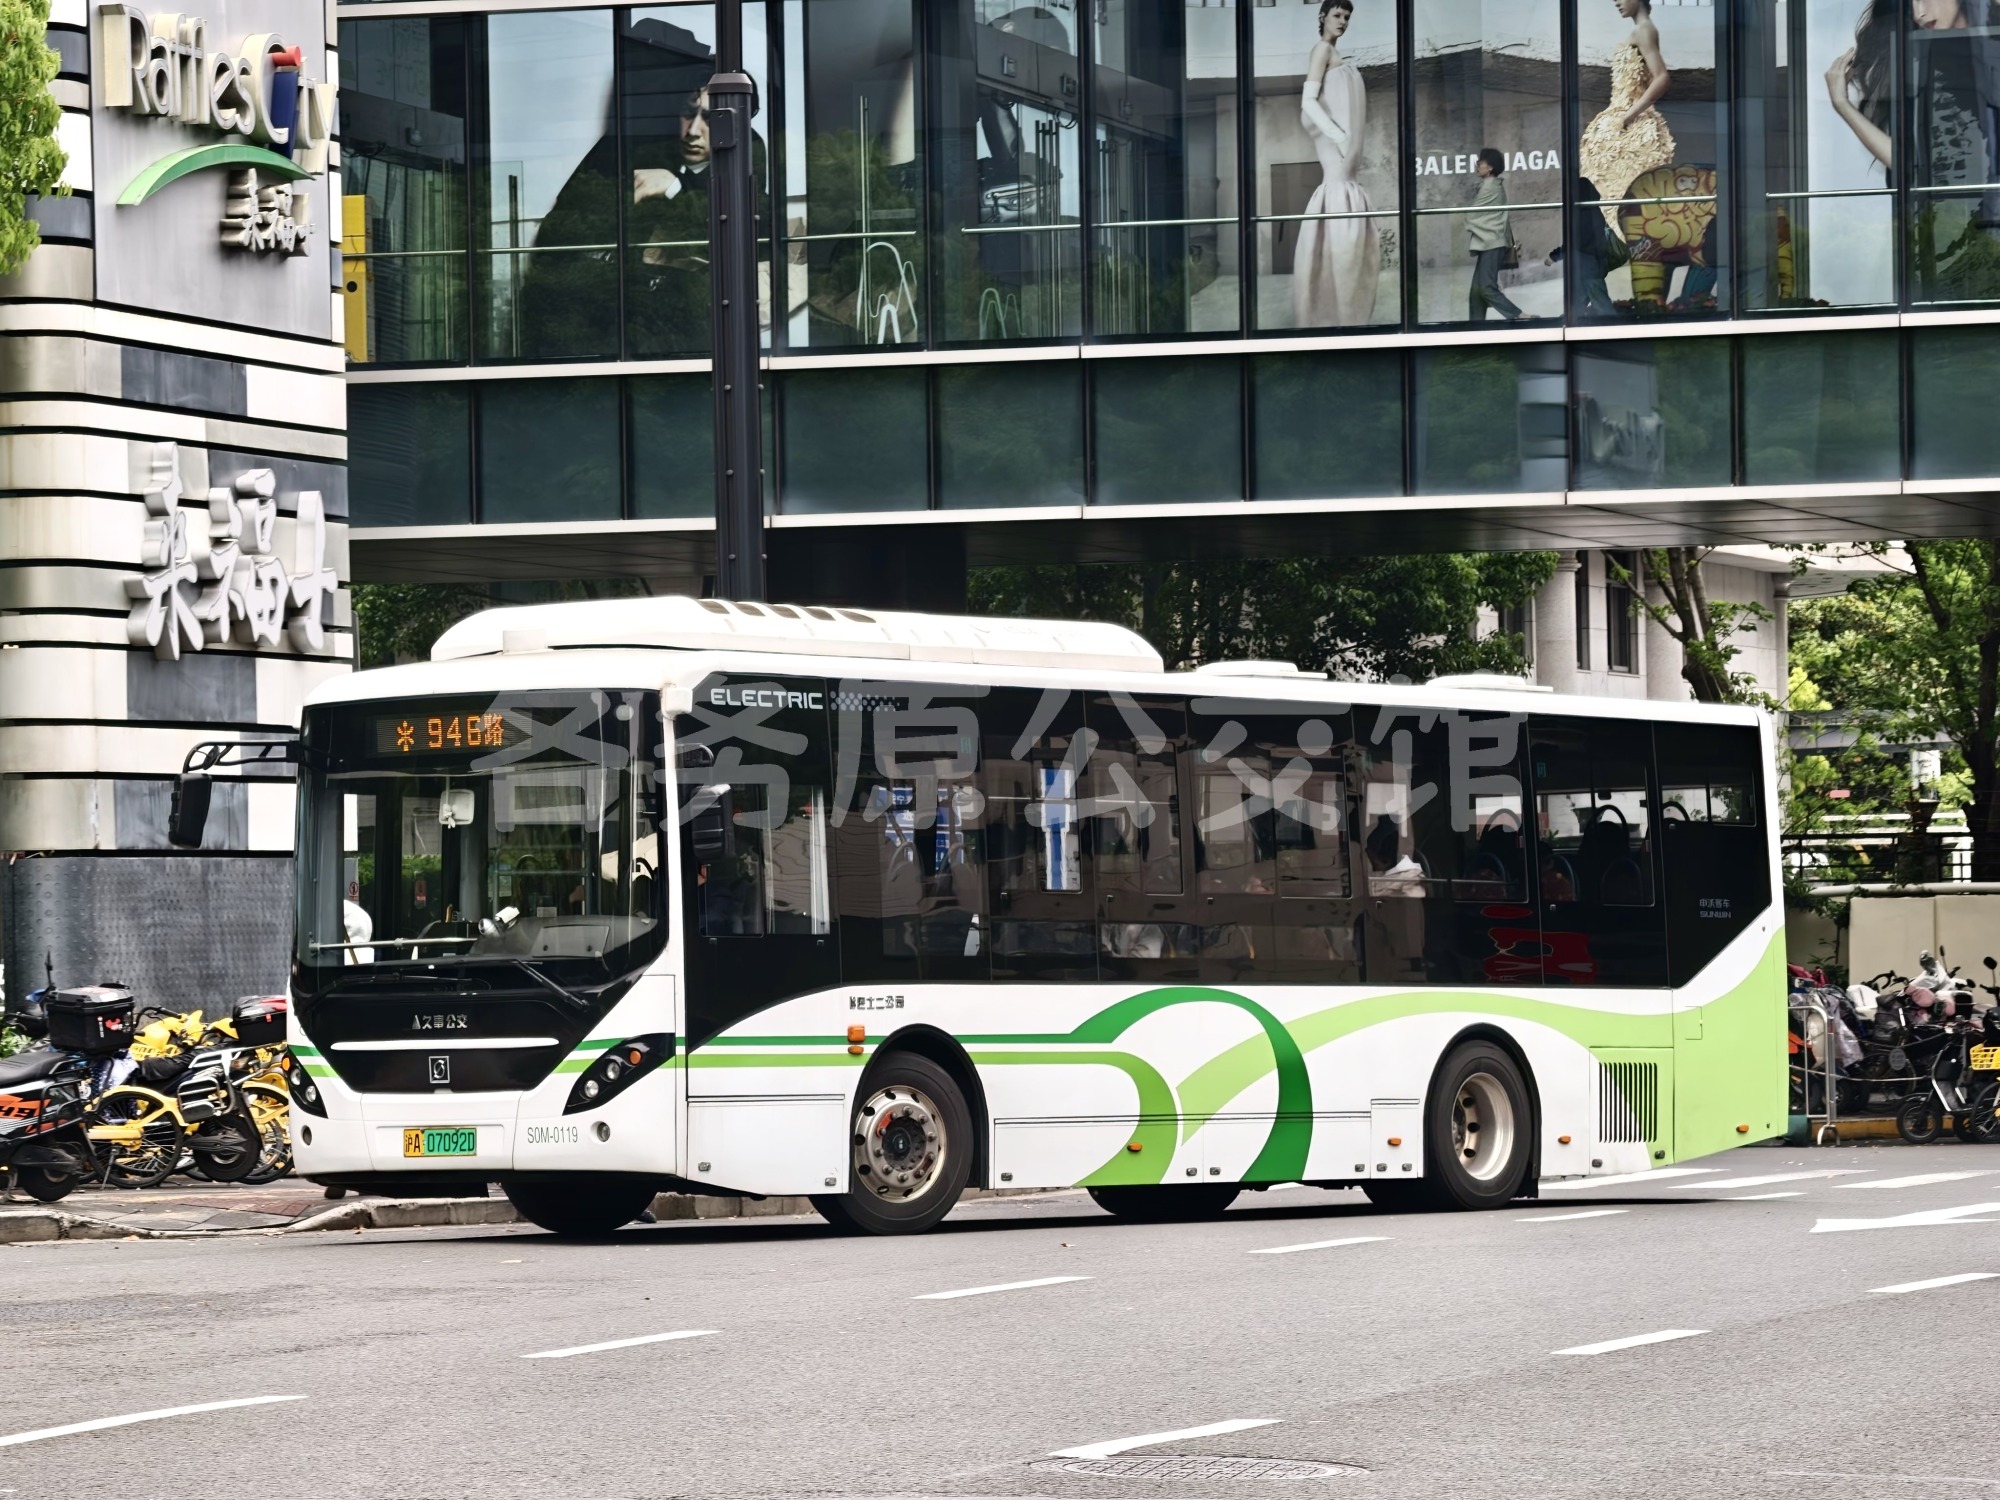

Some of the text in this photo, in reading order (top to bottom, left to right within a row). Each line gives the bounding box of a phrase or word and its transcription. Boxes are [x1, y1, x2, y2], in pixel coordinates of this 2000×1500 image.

[710, 688, 824, 710] ELECTRIC
[427, 713, 504, 749] 946路
[1699, 911, 1732, 919] SUNWIN
[422, 1014, 468, 1030] 久事公交
